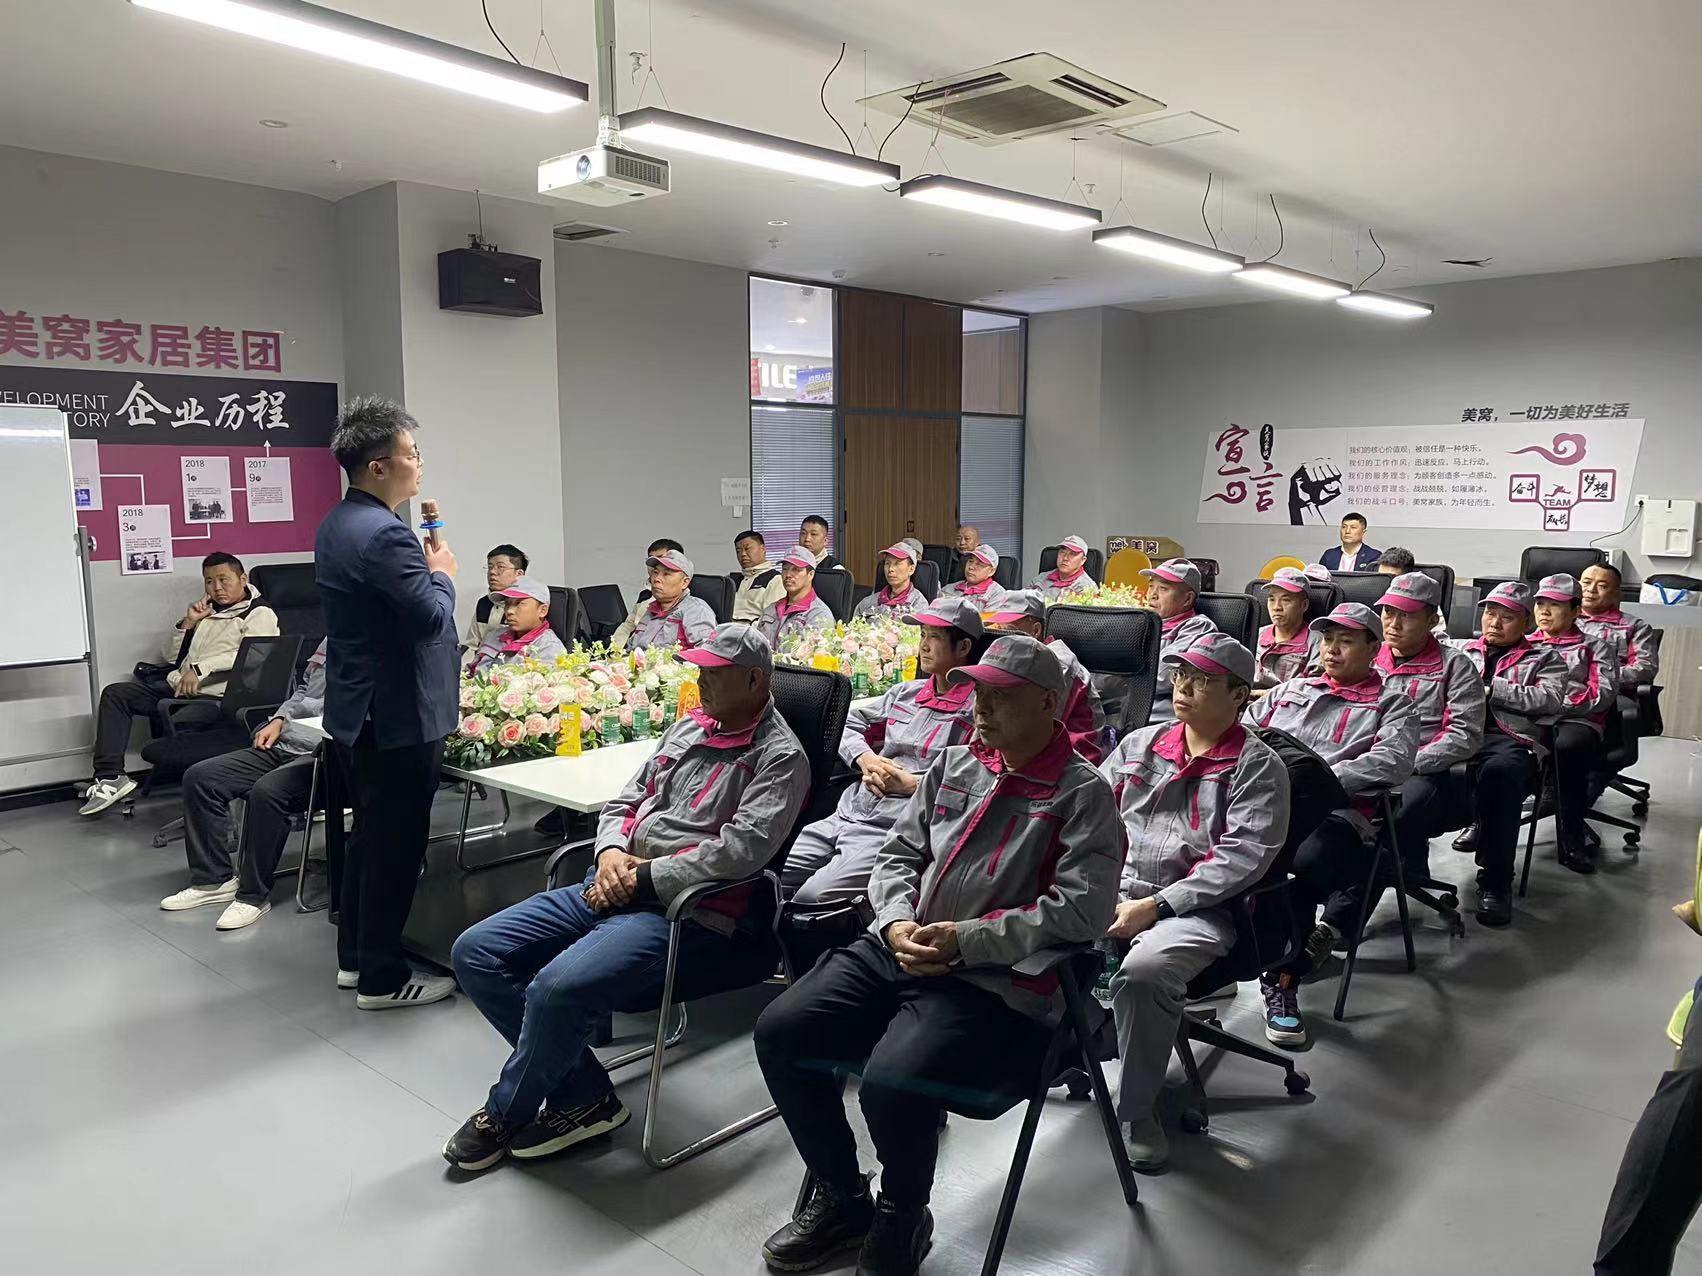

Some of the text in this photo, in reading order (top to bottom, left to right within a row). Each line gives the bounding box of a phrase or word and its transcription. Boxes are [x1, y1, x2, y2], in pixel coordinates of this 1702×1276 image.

[0, 309, 282, 373] 美窝家居集团
[115, 380, 290, 431] 企业历程
[66, 411, 110, 428] ORY
[185, 459, 205, 468] 2018
[248, 460, 267, 469] 2017
[122, 508, 144, 517] 2018
